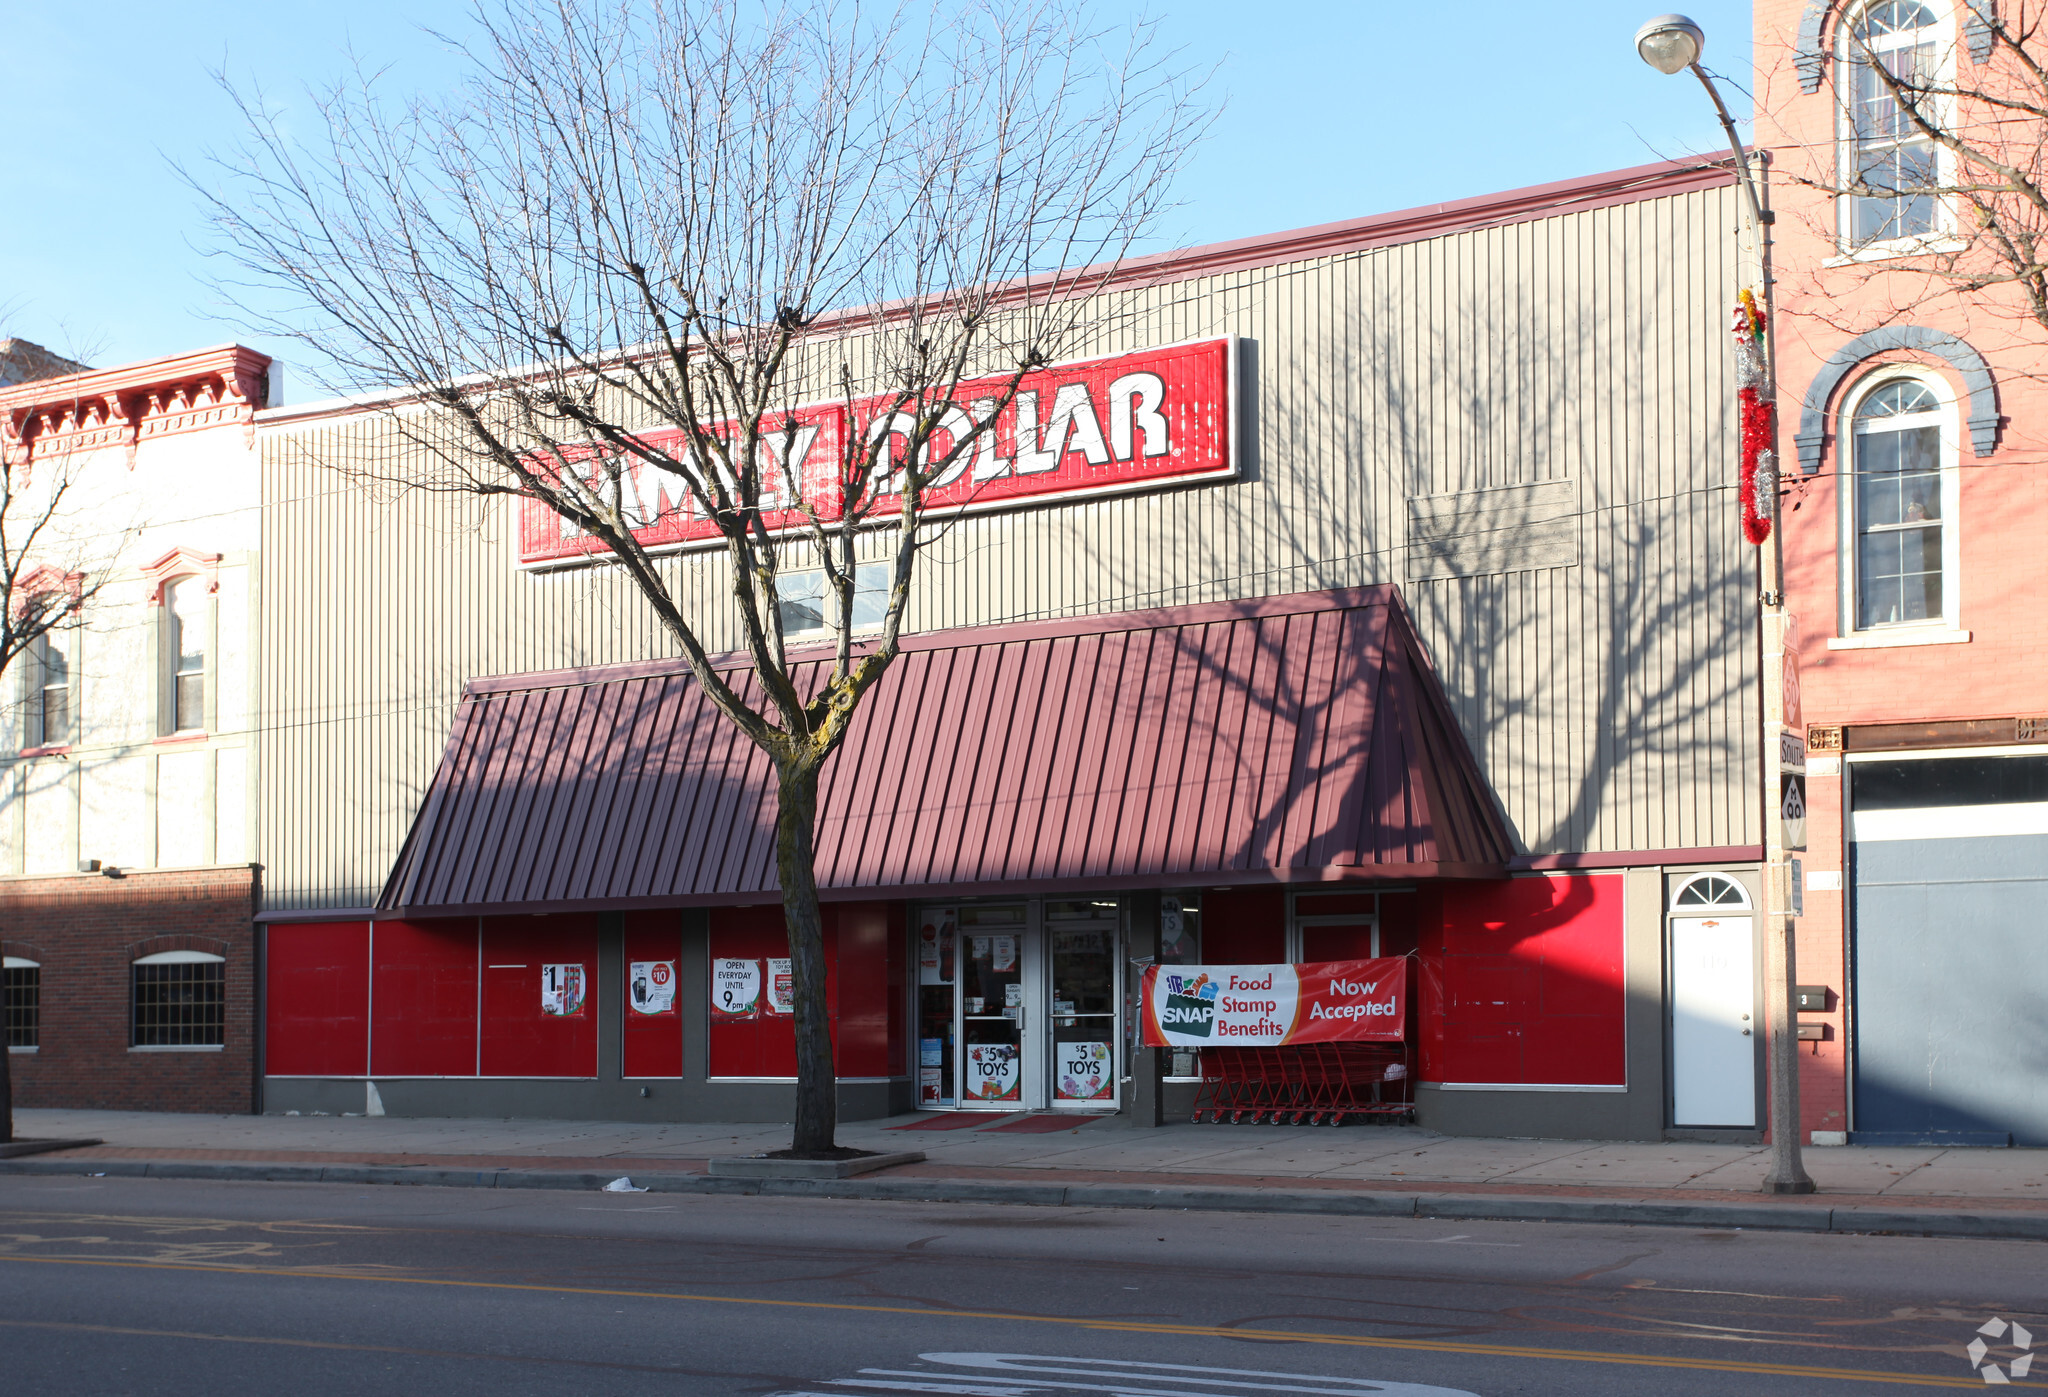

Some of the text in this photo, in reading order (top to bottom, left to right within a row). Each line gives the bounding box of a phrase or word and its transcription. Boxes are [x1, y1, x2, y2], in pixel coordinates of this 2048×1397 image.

[868, 370, 1170, 496] DOLLAR
[1781, 739, 1805, 766] SOUTH
[1790, 787, 1797, 801] M
[725, 961, 745, 970] OPEN
[543, 966, 556, 992] $1
[653, 971, 667, 982] $10
[718, 971, 752, 980] EVERYDAY
[1229, 973, 1273, 991] Food
[725, 981, 744, 990] UNTIL
[1330, 978, 1378, 997] Now
[1221, 995, 1277, 1017] Stamp
[1801, 994, 1807, 1005] 3
[1162, 1007, 1216, 1024] SNAP
[1308, 995, 1396, 1022] Accepted
[1218, 1018, 1284, 1038] Benefits
[984, 1047, 997, 1062] $5
[1075, 1045, 1088, 1060] $5
[976, 1062, 1009, 1077] TOYS
[1067, 1060, 1101, 1075] TOYS
